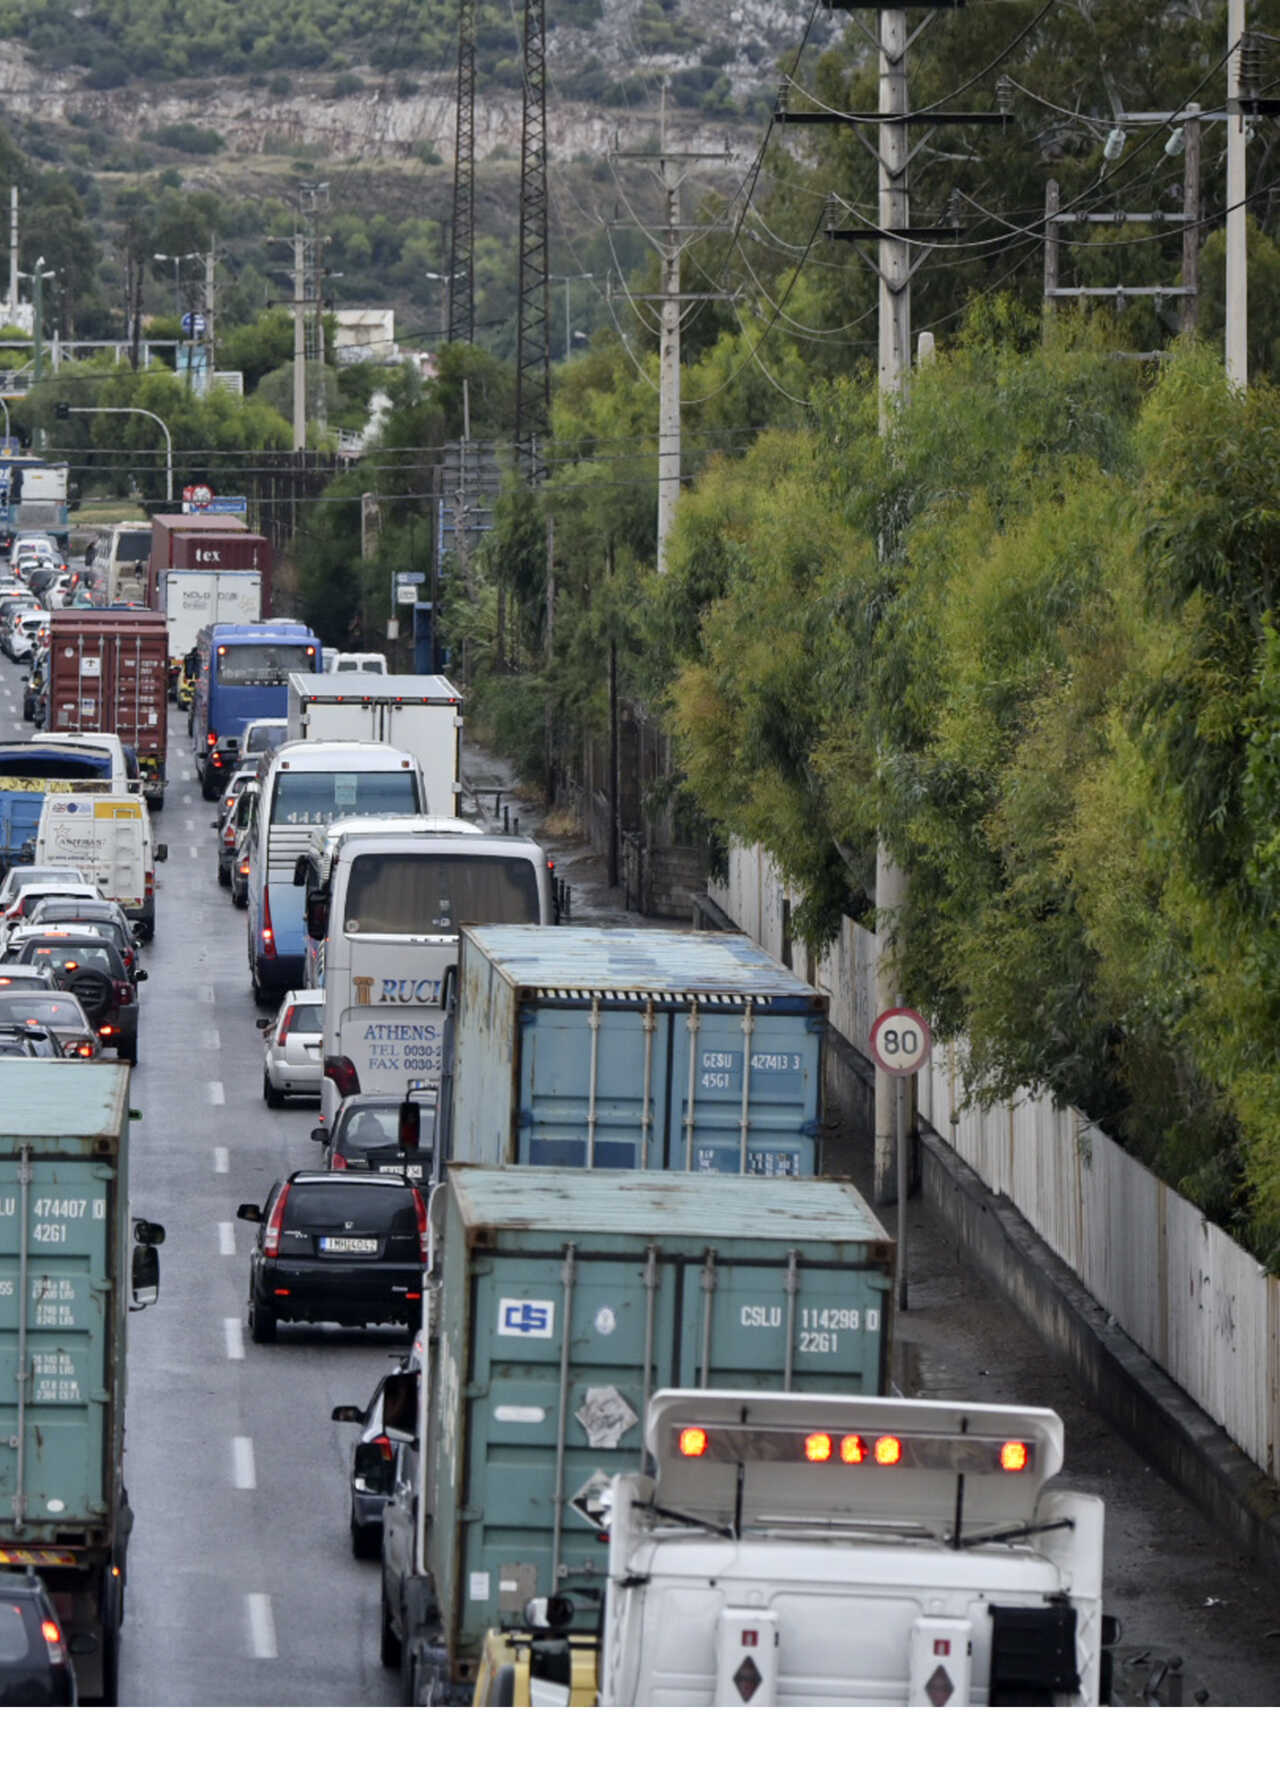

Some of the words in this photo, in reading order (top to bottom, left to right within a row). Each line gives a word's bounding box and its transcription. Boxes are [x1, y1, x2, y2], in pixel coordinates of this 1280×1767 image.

[195, 549, 220, 562] tex
[369, 1044, 399, 1056] TEL
[884, 1030, 917, 1055] 80
[369, 1058, 400, 1070] FAX
[703, 1054, 732, 1068] GESU
[34, 1199, 87, 1219] 474407
[33, 1223, 66, 1242] 42G1
[741, 1306, 781, 1327] CSLU
[803, 1309, 859, 1329] 114298
[800, 1332, 837, 1352] 22G1
